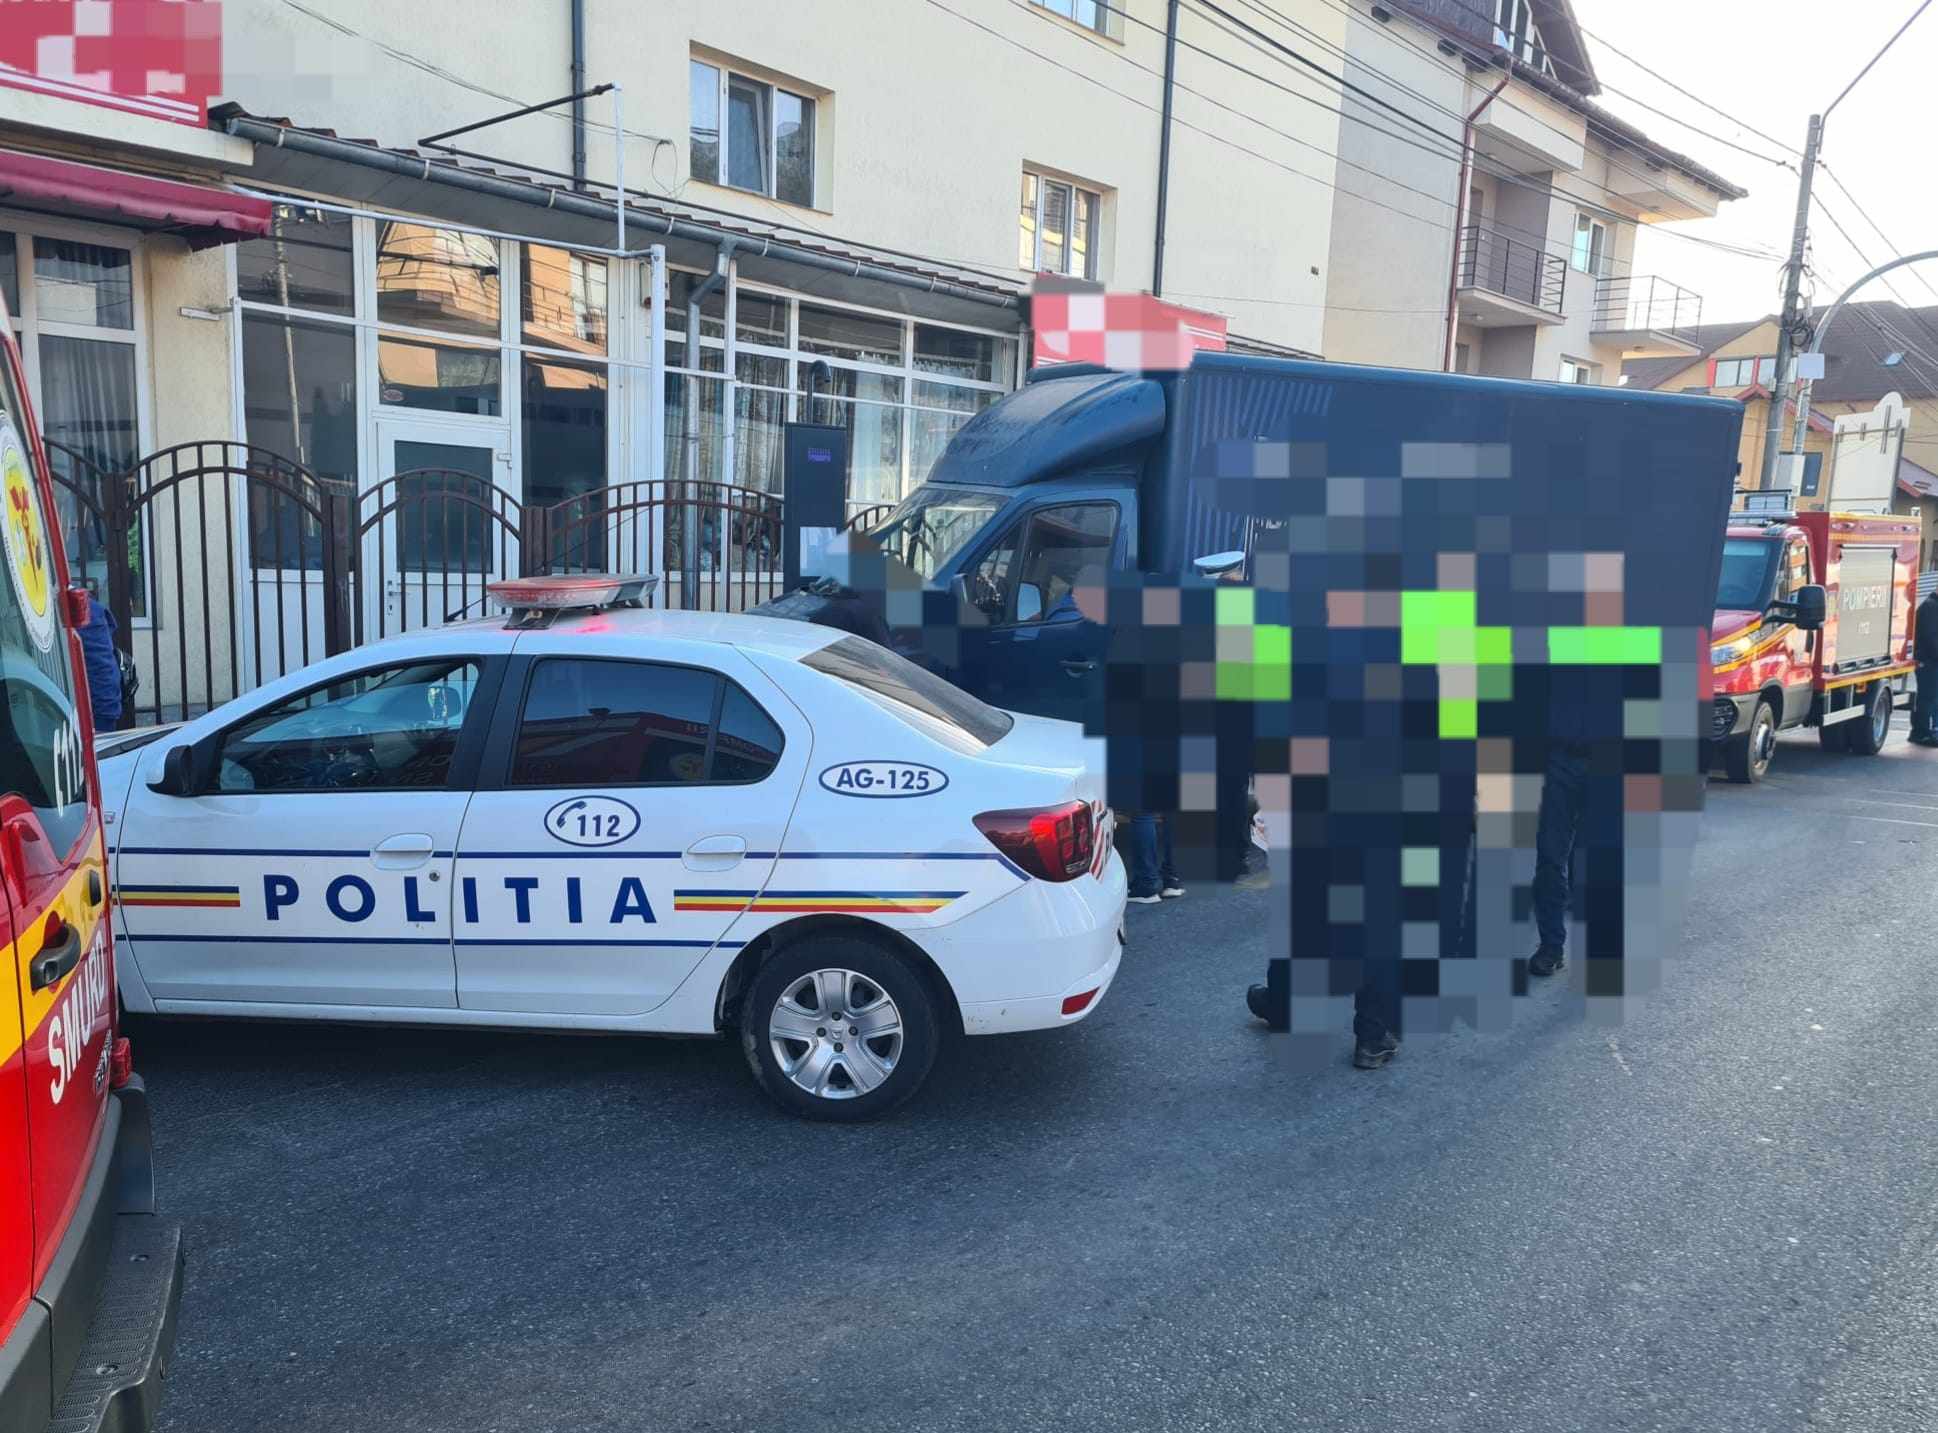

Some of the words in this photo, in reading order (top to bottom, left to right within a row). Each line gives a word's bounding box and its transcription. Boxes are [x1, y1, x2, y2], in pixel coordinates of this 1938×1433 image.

[836, 767, 929, 790] AG-125
[577, 813, 620, 837] 112
[263, 874, 657, 923] POLITIA
[49, 930, 106, 1104] SMURD
